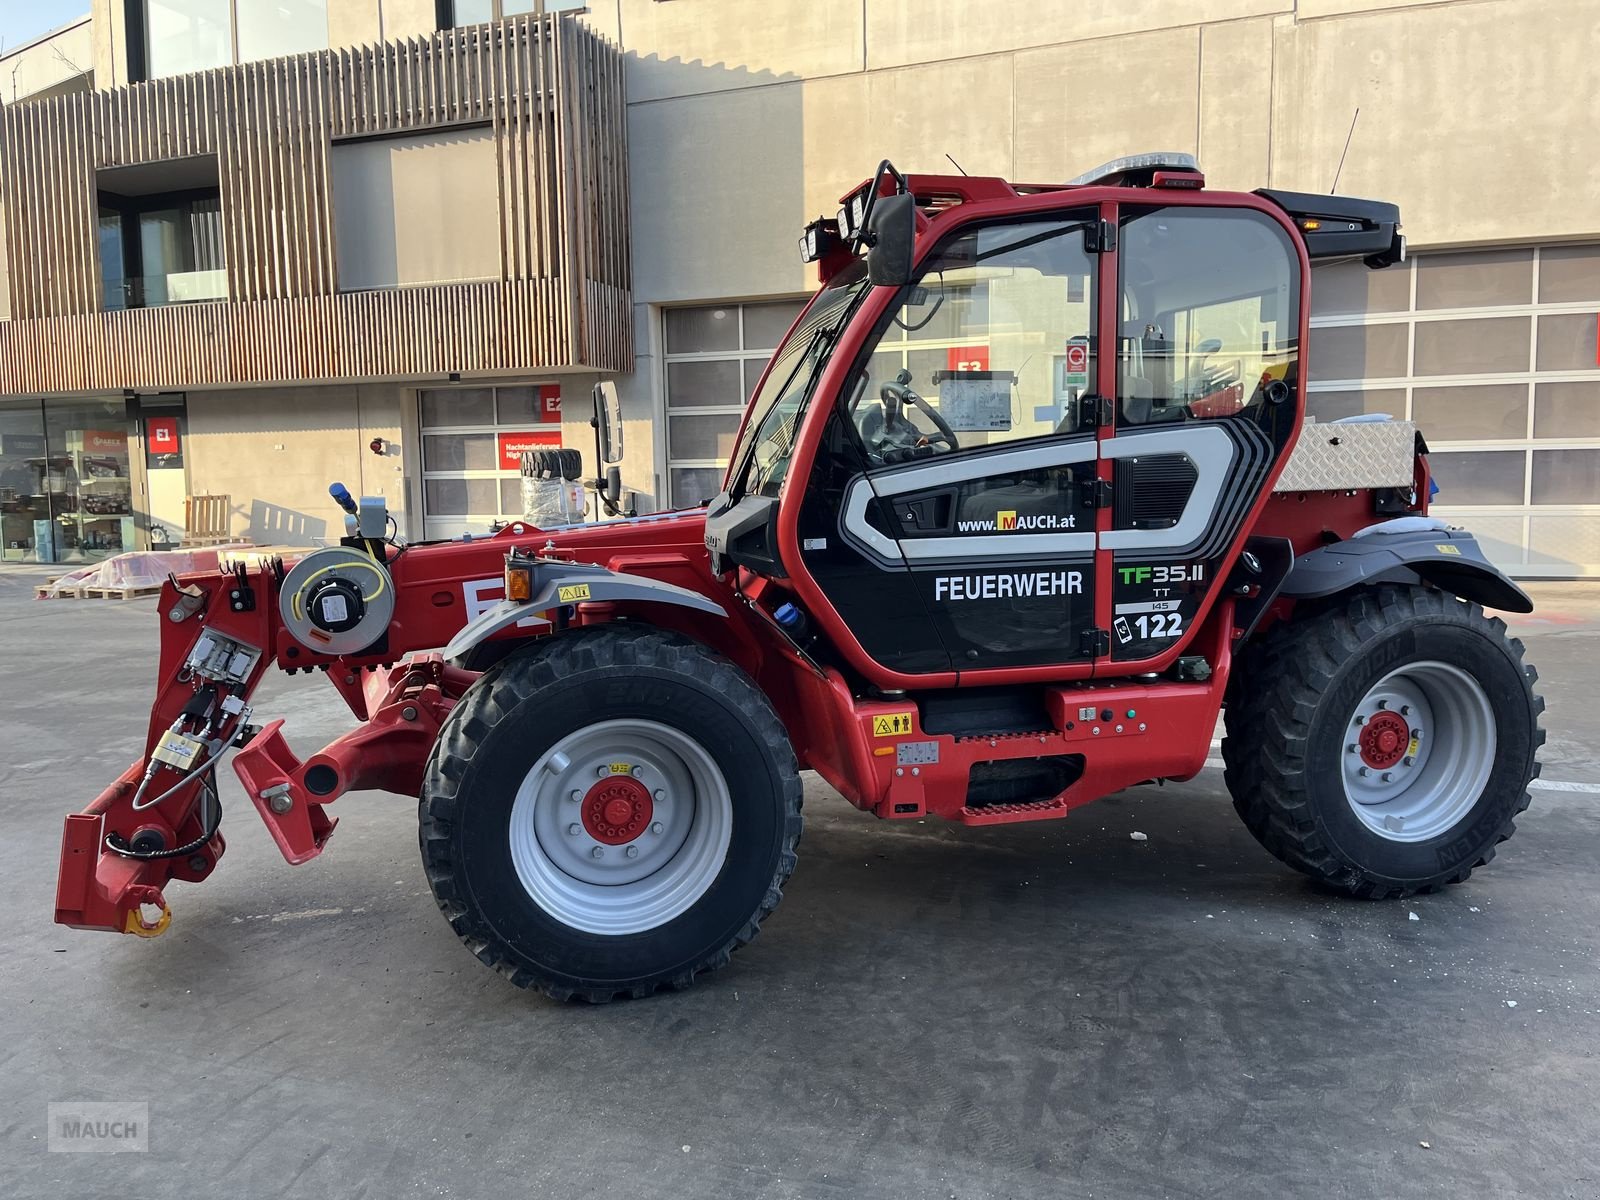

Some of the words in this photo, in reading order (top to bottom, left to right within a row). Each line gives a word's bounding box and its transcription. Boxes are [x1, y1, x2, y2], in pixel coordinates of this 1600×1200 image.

[546, 397, 561, 412] E2
[156, 428, 171, 442] E1
[506, 451, 521, 459] Nigh
[958, 512, 1075, 531] www.MAUCH.at
[935, 571, 1083, 601] FEUERWEHR
[1152, 588, 1170, 597] TT
[1152, 602, 1169, 610] 145
[1134, 612, 1182, 639] 122
